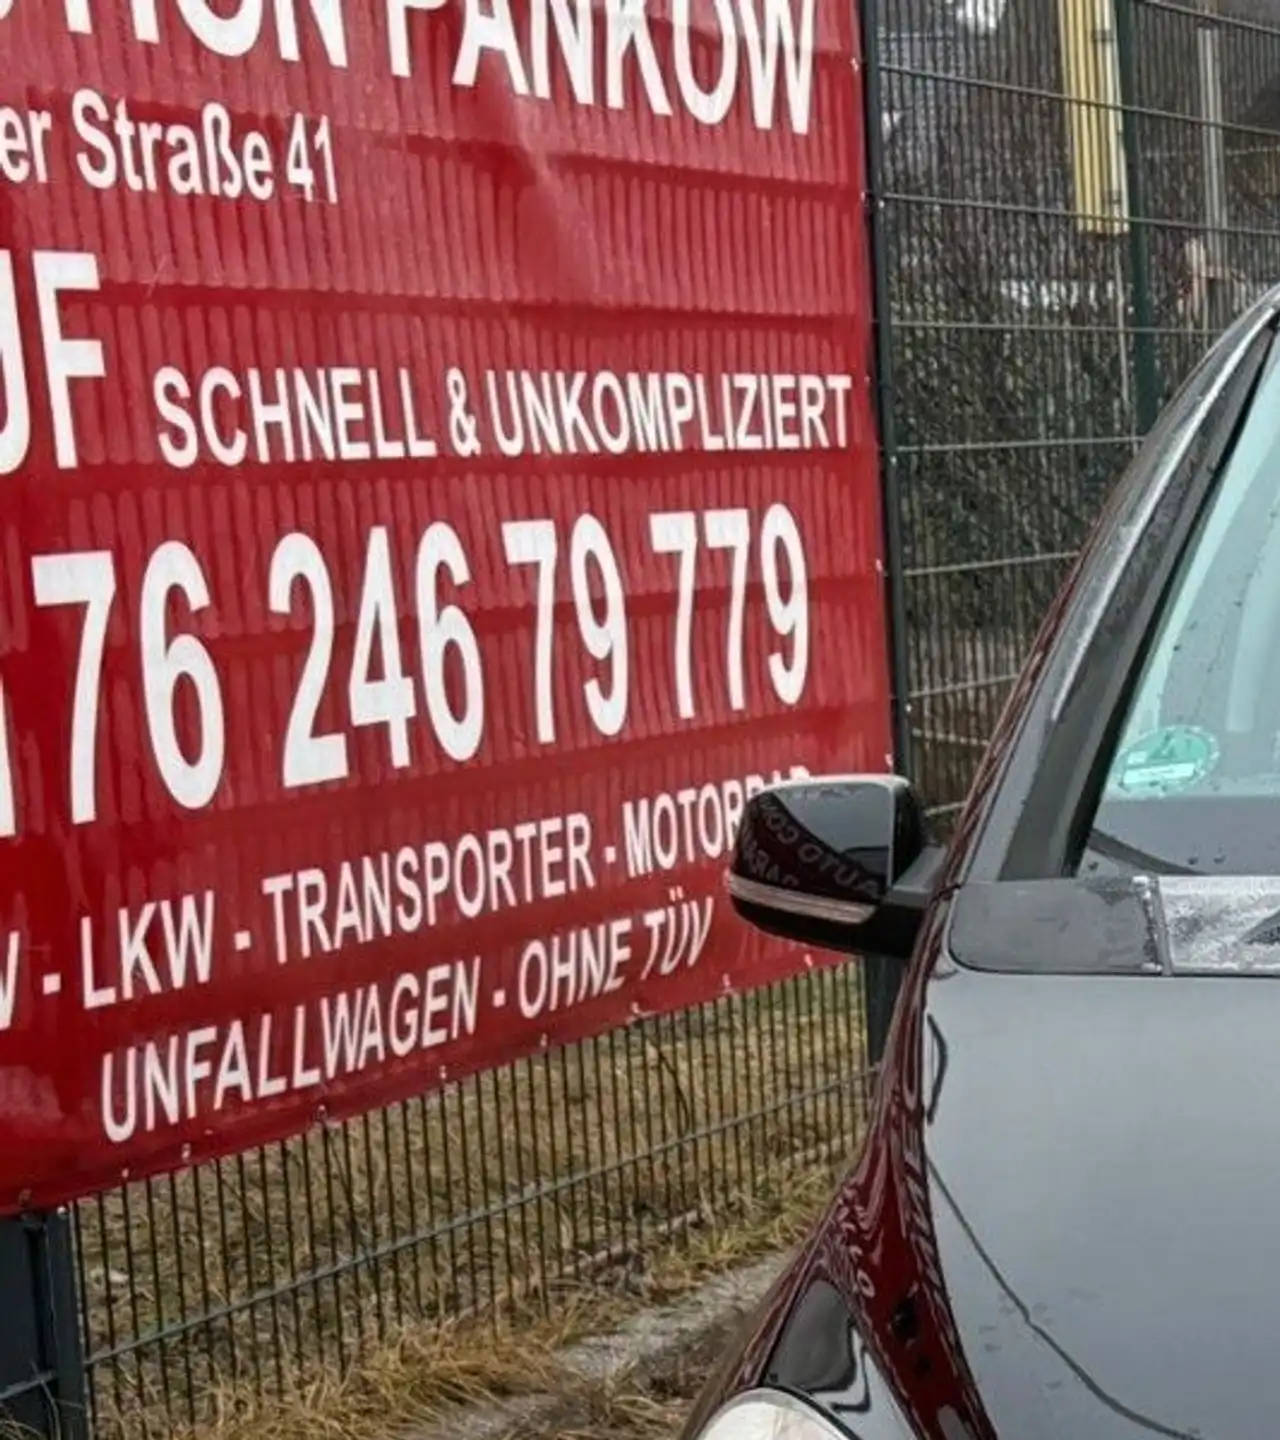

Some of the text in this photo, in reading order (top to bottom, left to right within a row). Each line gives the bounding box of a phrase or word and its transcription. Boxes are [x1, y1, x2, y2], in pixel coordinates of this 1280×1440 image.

[72, 88, 274, 200] Straße
[286, 112, 338, 204] 41
[153, 366, 852, 468] SCHNELL & UNKOMPLIZIERT
[269, 521, 484, 788] 246
[501, 513, 628, 743] 79
[649, 503, 808, 719] 779
[81, 890, 214, 1009] LKW
[263, 813, 595, 964] TRANSPORTER
[623, 766, 811, 877] MOTOR
[103, 958, 480, 1142] UNFALLWAGEN
[519, 919, 632, 1017] OHNE
[644, 886, 714, 974] TÜV
